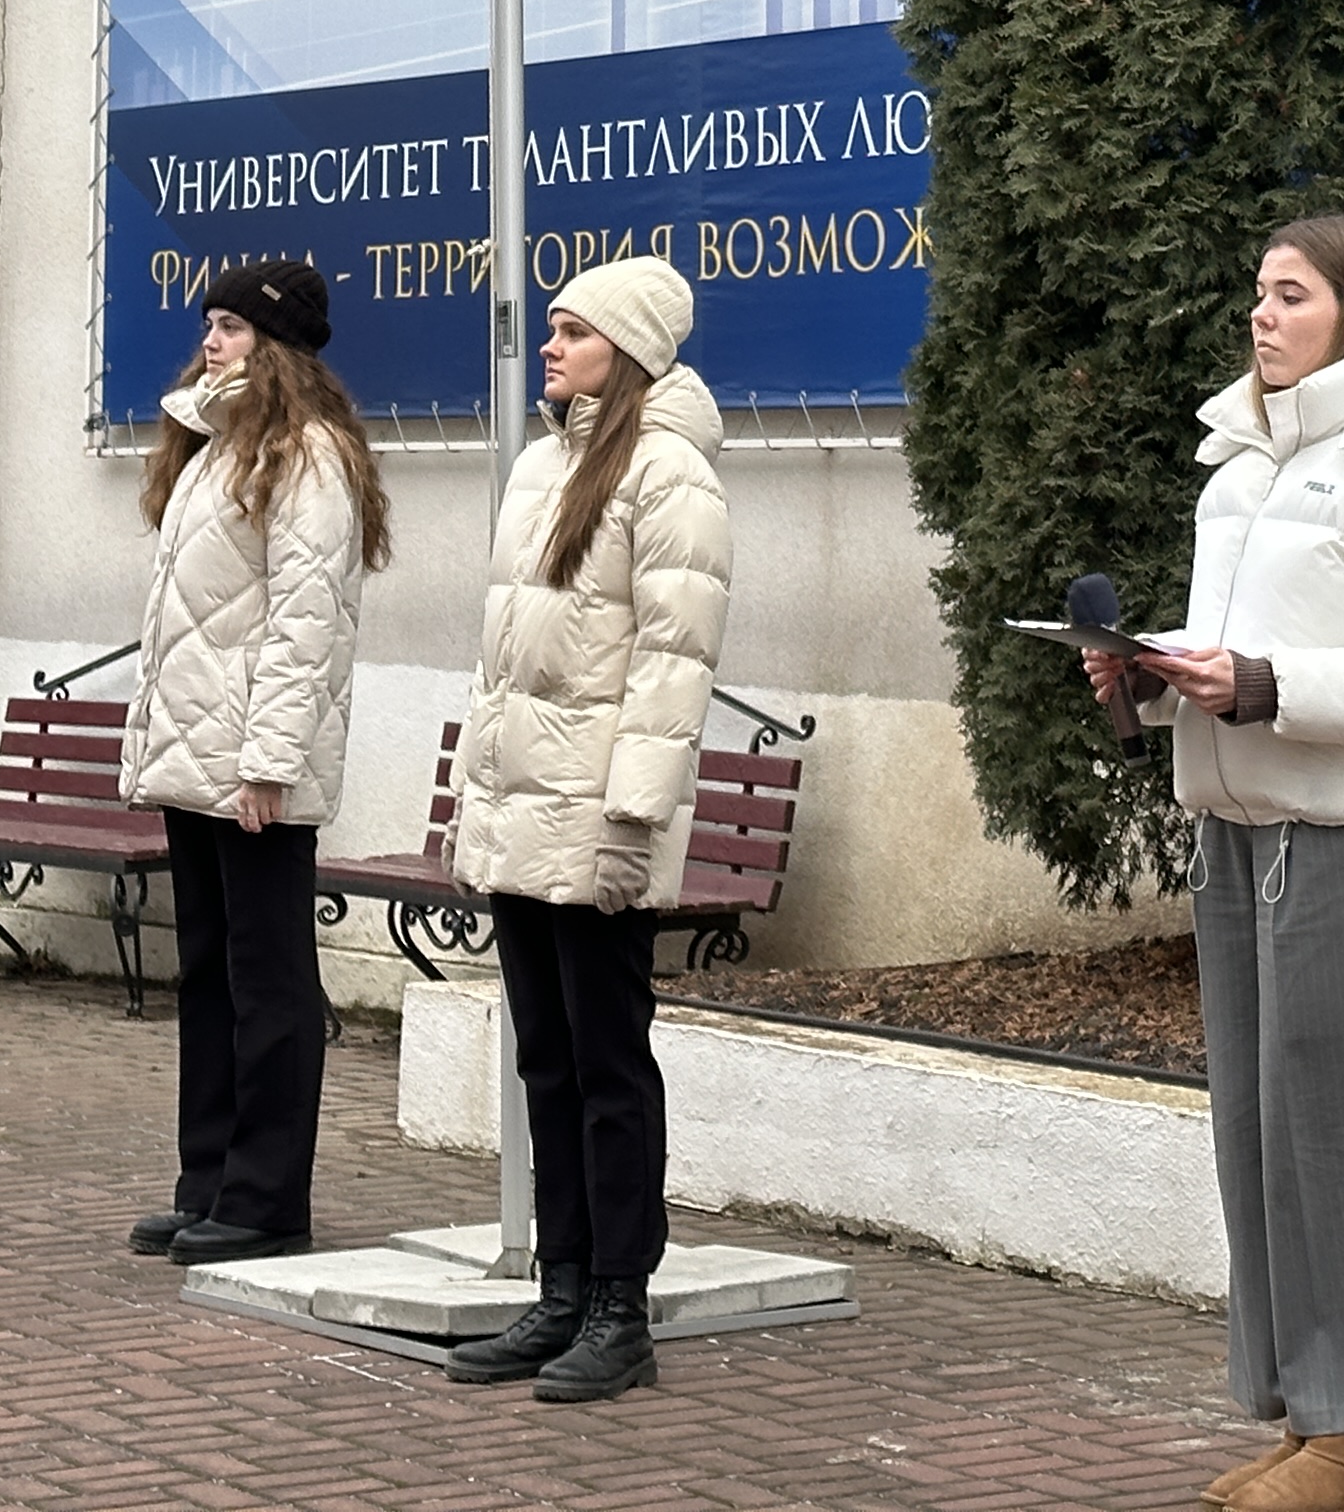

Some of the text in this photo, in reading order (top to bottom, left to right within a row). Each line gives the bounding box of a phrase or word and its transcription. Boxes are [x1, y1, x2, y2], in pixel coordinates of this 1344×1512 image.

[148, 89, 933, 217] УНИВЕРСИТЕТ ТЛАНТЛИВЫХ ЛЮ
[366, 225, 674, 301] ТЕРРИОРИЯ
[696, 205, 938, 282] ВОЗМОЖ
